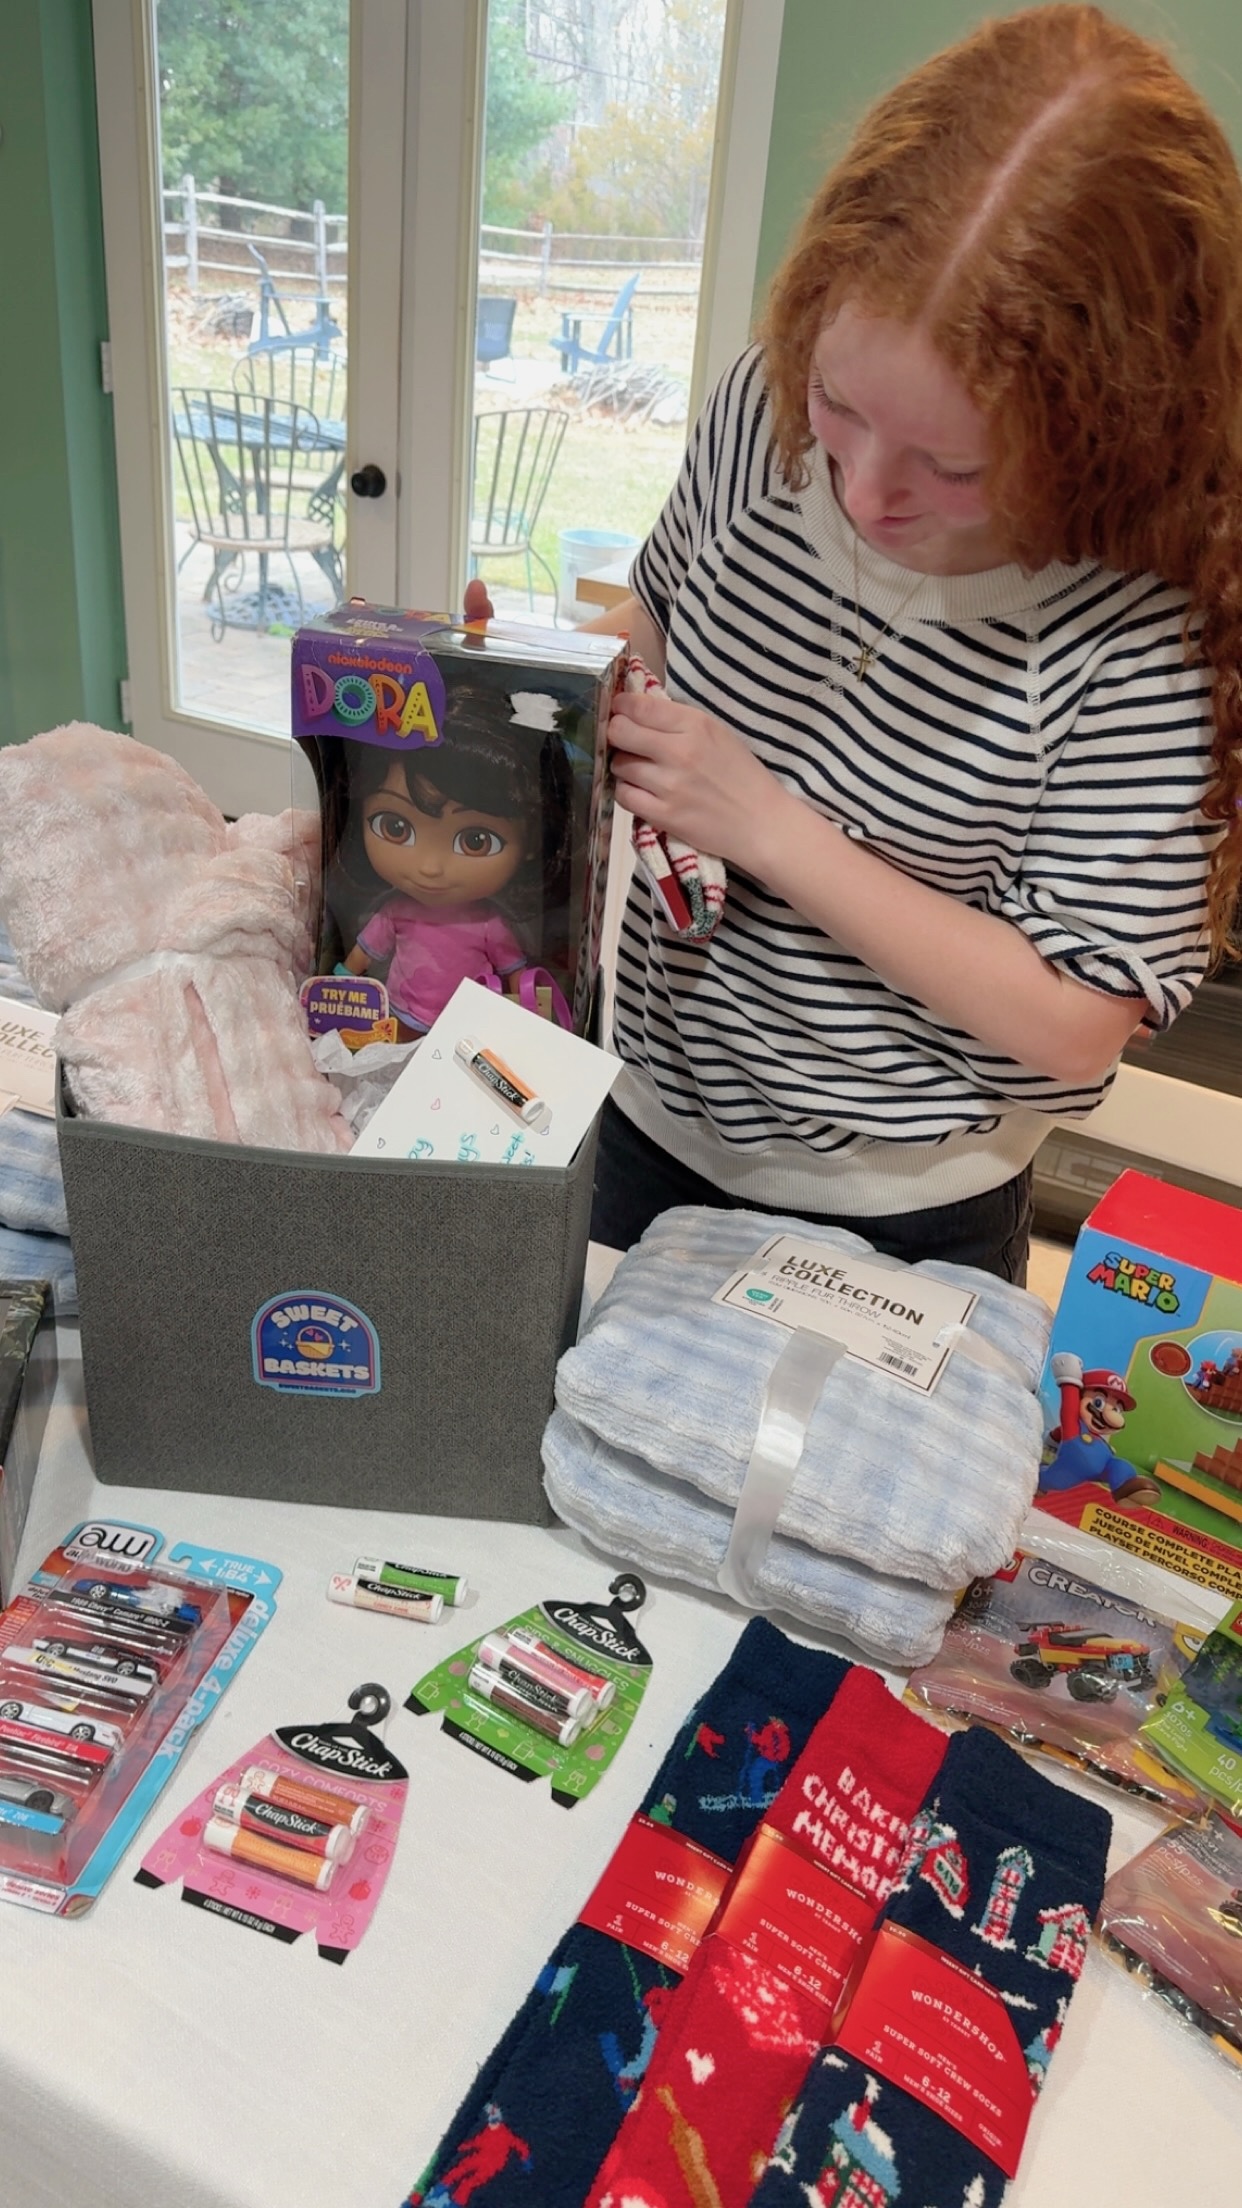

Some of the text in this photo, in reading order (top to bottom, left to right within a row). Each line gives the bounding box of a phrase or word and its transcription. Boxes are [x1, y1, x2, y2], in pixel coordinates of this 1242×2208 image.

[327, 652, 414, 675] nickelodeon
[301, 663, 439, 743] DORA
[321, 988, 368, 1005] TRY ME
[309, 1001, 380, 1021] PRUÉBAME
[0, 1020, 45, 1041] UXE
[478, 1060, 519, 1101] ChapStick
[786, 1254, 848, 1281] LUXE
[1102, 1251, 1176, 1291] SUPER
[770, 1274, 883, 1319] RIPPLE FUR THROW
[778, 1264, 925, 1326] COLLECTION
[1087, 1262, 1181, 1314] MARIO
[270, 1304, 359, 1332] SWEET
[263, 1357, 370, 1381] BASKETS
[79, 1526, 150, 1557] aw
[1091, 1516, 1132, 1540] JUEGO
[1134, 1535, 1150, 1549] DE
[1152, 1543, 1190, 1567] NIVEL
[1094, 1507, 1146, 1536] COURSE
[1147, 1530, 1214, 1568] COMPLETE
[222, 1558, 255, 1573] TRUE
[1088, 1525, 1140, 1553] PLAYSET
[1141, 1548, 1206, 1584] PERCORSO
[215, 1567, 248, 1583] 1:64
[367, 1582, 423, 1601] ChapStick
[971, 1582, 993, 1598] 6+
[215, 1600, 269, 1672] deluxe
[553, 1606, 640, 1662] ChapStick
[507, 1668, 559, 1704] ChapStick
[156, 1676, 222, 1760] 4-pack
[1170, 1701, 1196, 1721] 6+
[291, 1732, 392, 1778] ChapStick
[1217, 1754, 1237, 1771] 40
[258, 1759, 301, 1778] COZY
[303, 1772, 388, 1814] COMFORTS
[255, 1803, 317, 1834] ChapStick
[702, 1852, 714, 1862] GIFT
[1167, 1839, 1186, 1855] 55
[829, 1869, 841, 1880] GIFT
[606, 1922, 624, 1934] PAIR
[613, 1914, 623, 1926] 1
[625, 1900, 657, 1921] SUPER
[657, 1917, 683, 1936] SOFT
[643, 1940, 664, 1956] MEN'S
[660, 1940, 669, 1950] 6
[675, 1949, 690, 1963] 12
[741, 1939, 759, 1953] PAIR
[749, 1931, 758, 1945] 1
[759, 1918, 842, 1981] SUPER SOFT CREW
[808, 1945, 829, 1962] MEN'S
[776, 1963, 798, 1981] MEN'S
[797, 1978, 815, 1995] SHOE
[793, 1965, 802, 1975] 6
[807, 1976, 823, 1991] 12
[940, 1955, 998, 1999] INSERT GIFT CARD HERE
[910, 1989, 1005, 2063] WONDERSHOP
[864, 2047, 884, 2064] PAIR
[872, 2040, 882, 2053] 1
[882, 2024, 1003, 2118] SUPER SOFT CREW SOCKS
[936, 2052, 958, 2071] MEN'S
[903, 2073, 963, 2123] MEN'S SHOE SIZES
[921, 2075, 931, 2088] 6
[936, 2085, 952, 2102] 12
